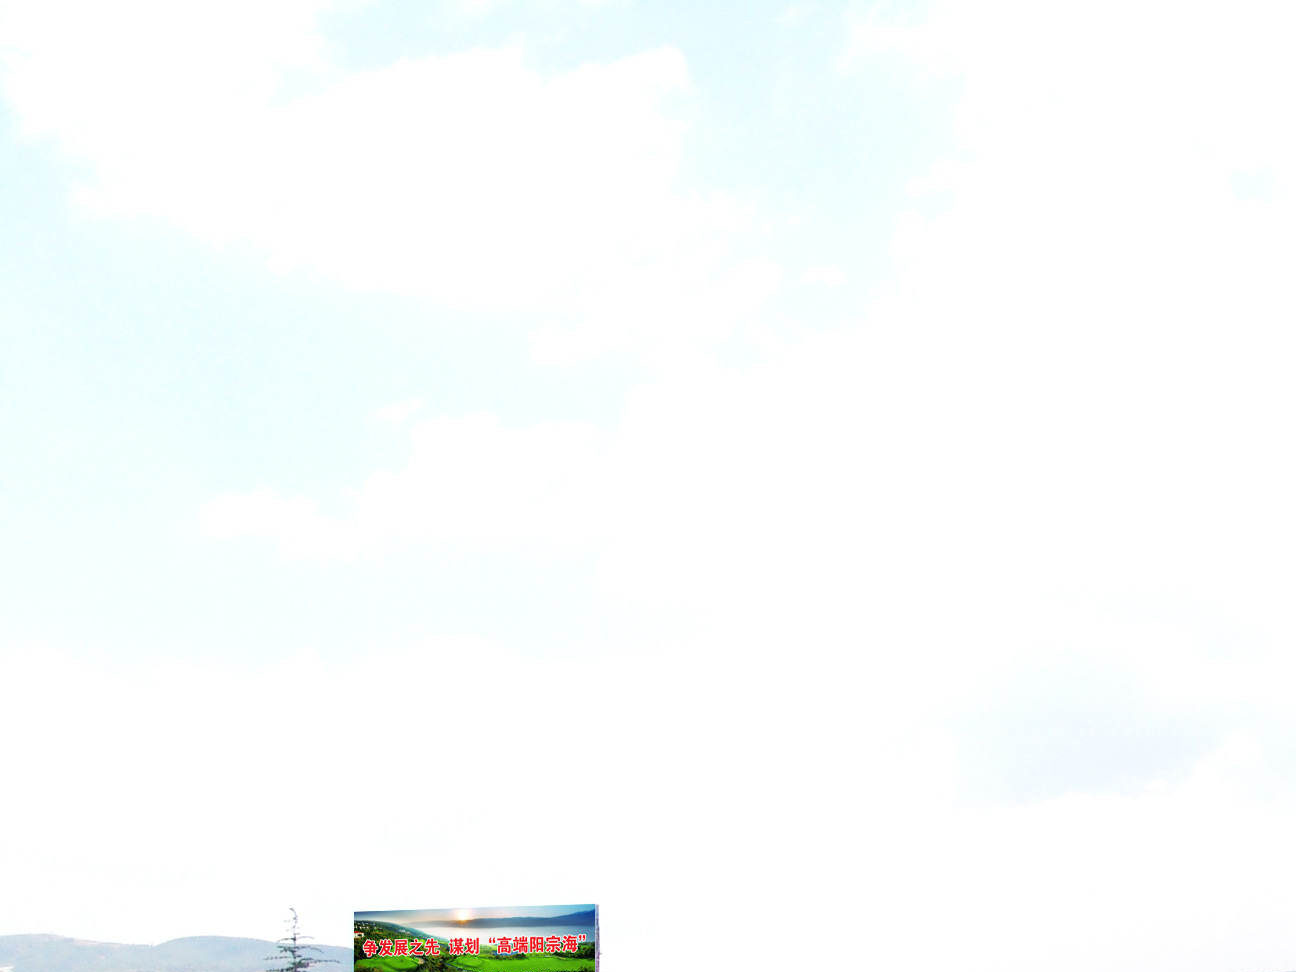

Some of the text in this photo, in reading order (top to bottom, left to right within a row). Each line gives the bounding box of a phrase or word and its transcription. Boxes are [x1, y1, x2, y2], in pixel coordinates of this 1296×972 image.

[362, 937, 440, 957] 争发展之先
[448, 936, 480, 955] 谋划
